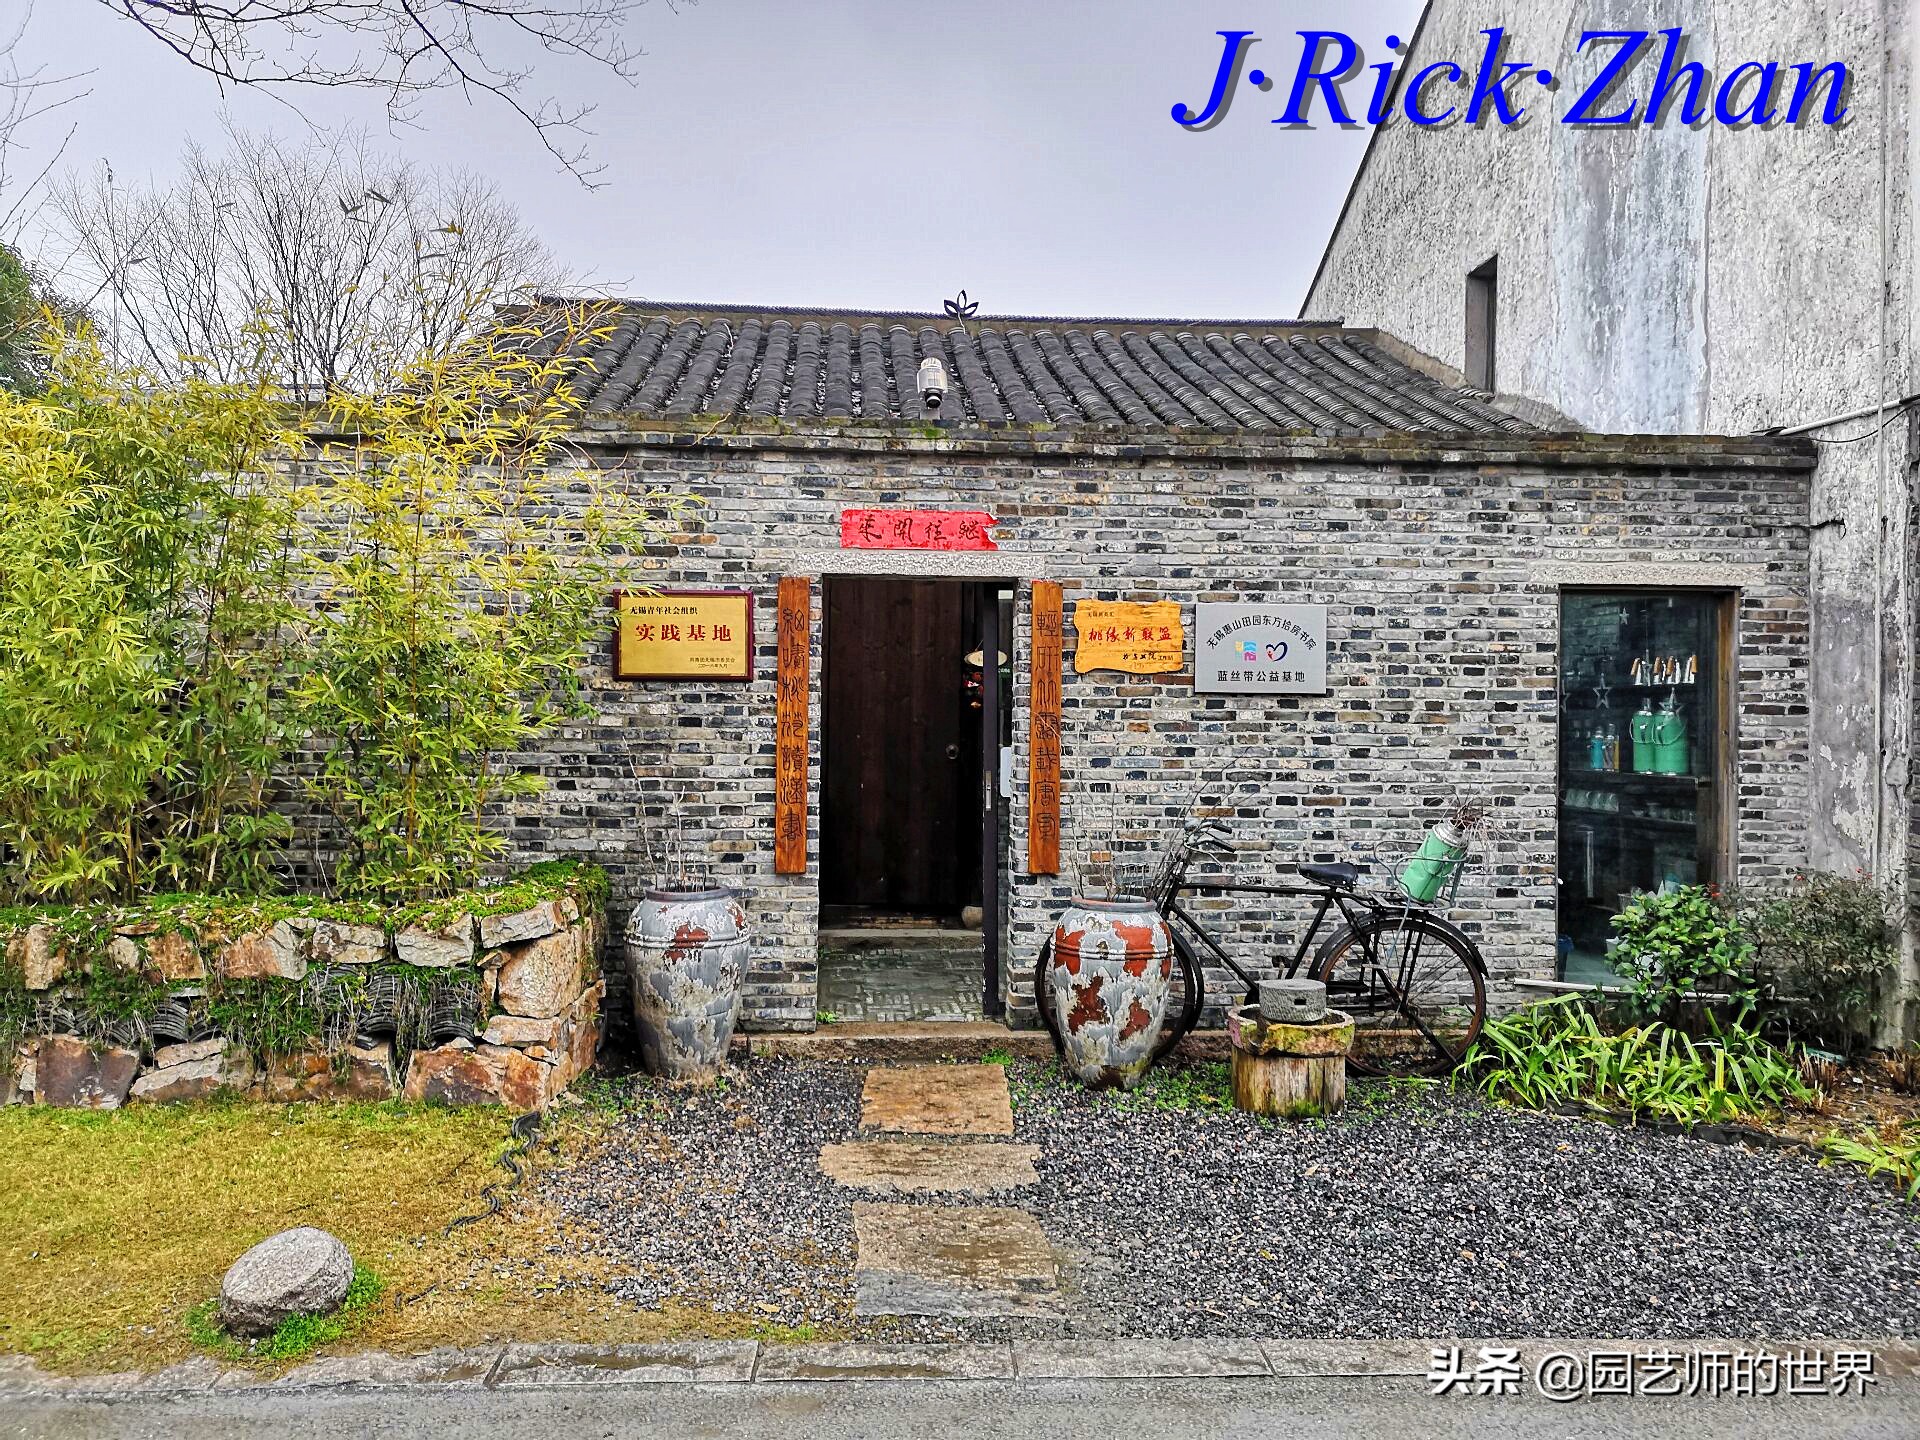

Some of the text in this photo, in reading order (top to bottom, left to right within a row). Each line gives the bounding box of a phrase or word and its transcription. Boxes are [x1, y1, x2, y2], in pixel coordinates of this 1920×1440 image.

[629, 606, 698, 615] 无锡青年社会组织
[635, 624, 732, 642] 实践基地
[1206, 615, 1317, 650] 无锡惠山田园东方拾房书院
[1217, 671, 1306, 683] 蓝丝带公益基地
